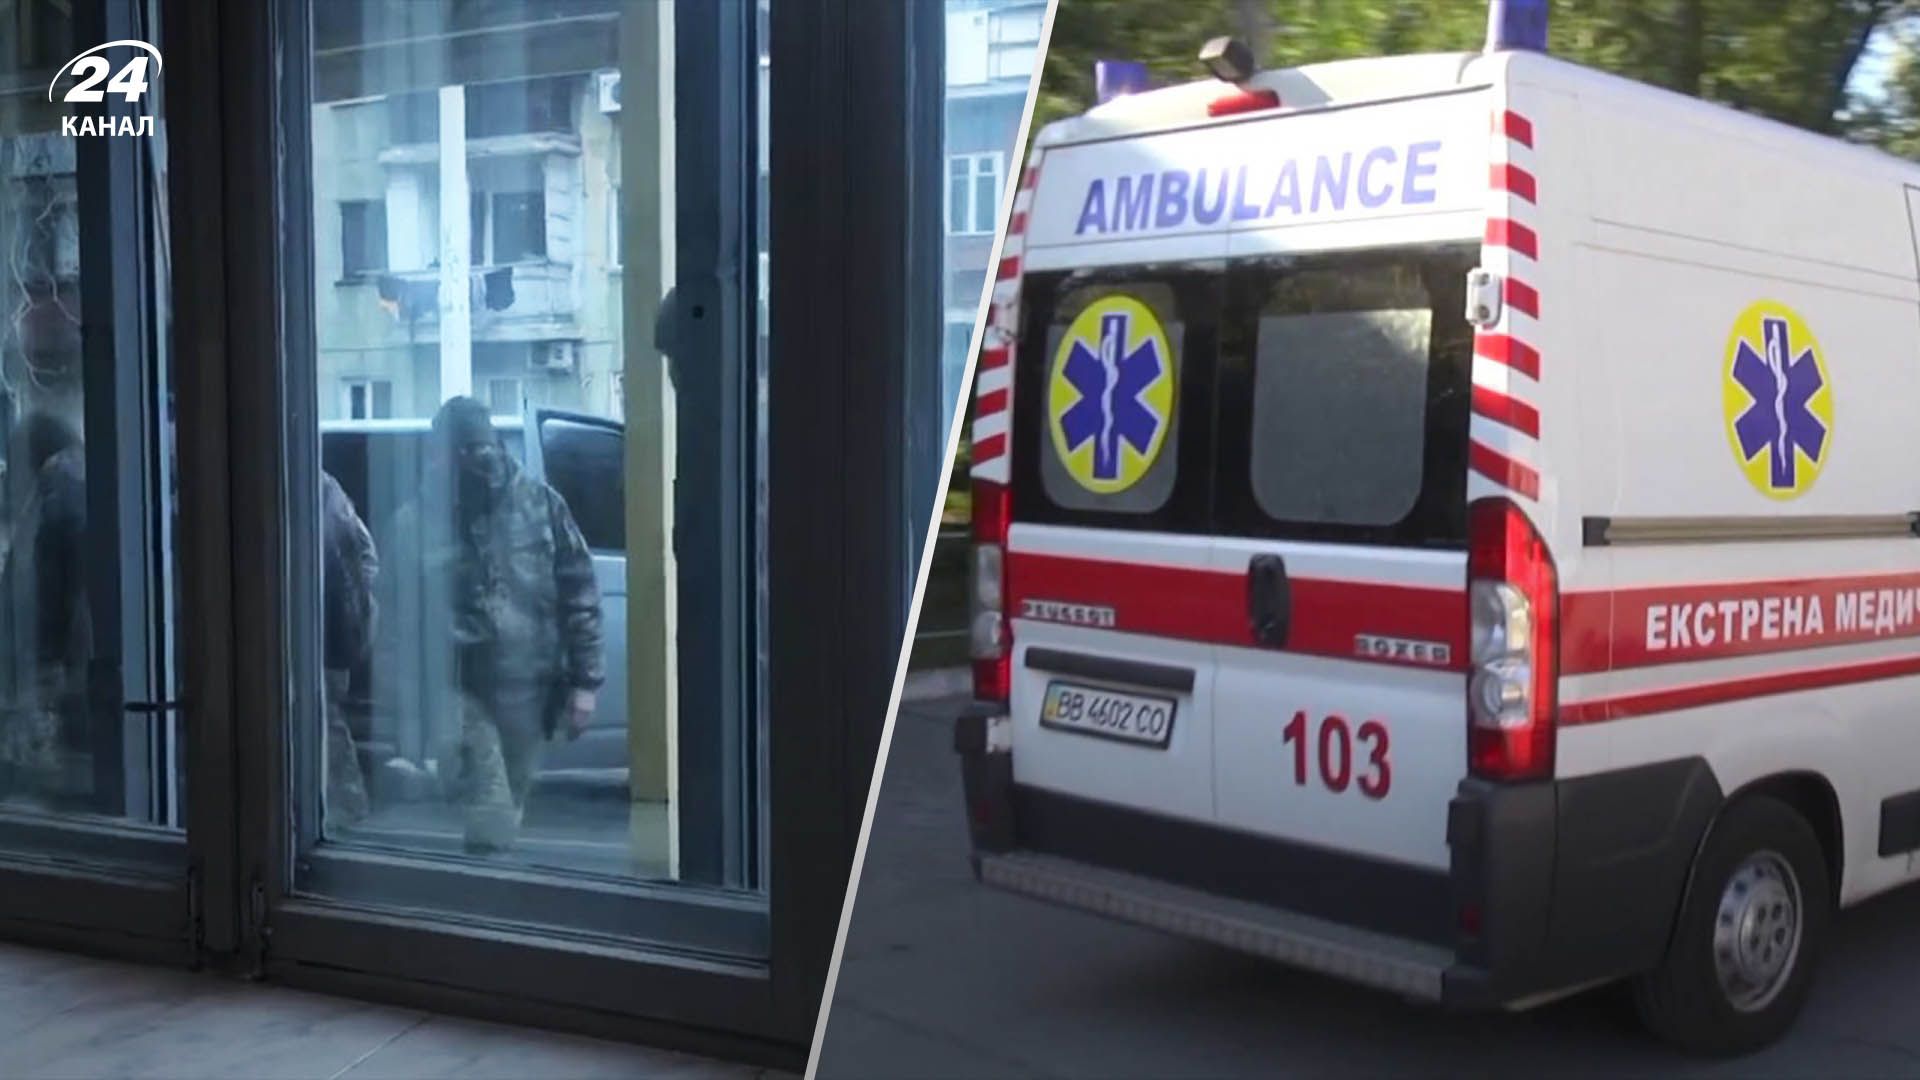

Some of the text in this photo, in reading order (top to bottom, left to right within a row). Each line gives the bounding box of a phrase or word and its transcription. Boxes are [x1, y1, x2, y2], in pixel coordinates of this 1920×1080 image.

[1074, 140, 1442, 236] AMBULANCE
[1022, 599, 1116, 627] PEUGEOT
[1646, 594, 1824, 651] ЕКСТРЕНА
[1056, 690, 1085, 722] BB
[1136, 703, 1166, 737] CO
[1283, 710, 1392, 801] 103
